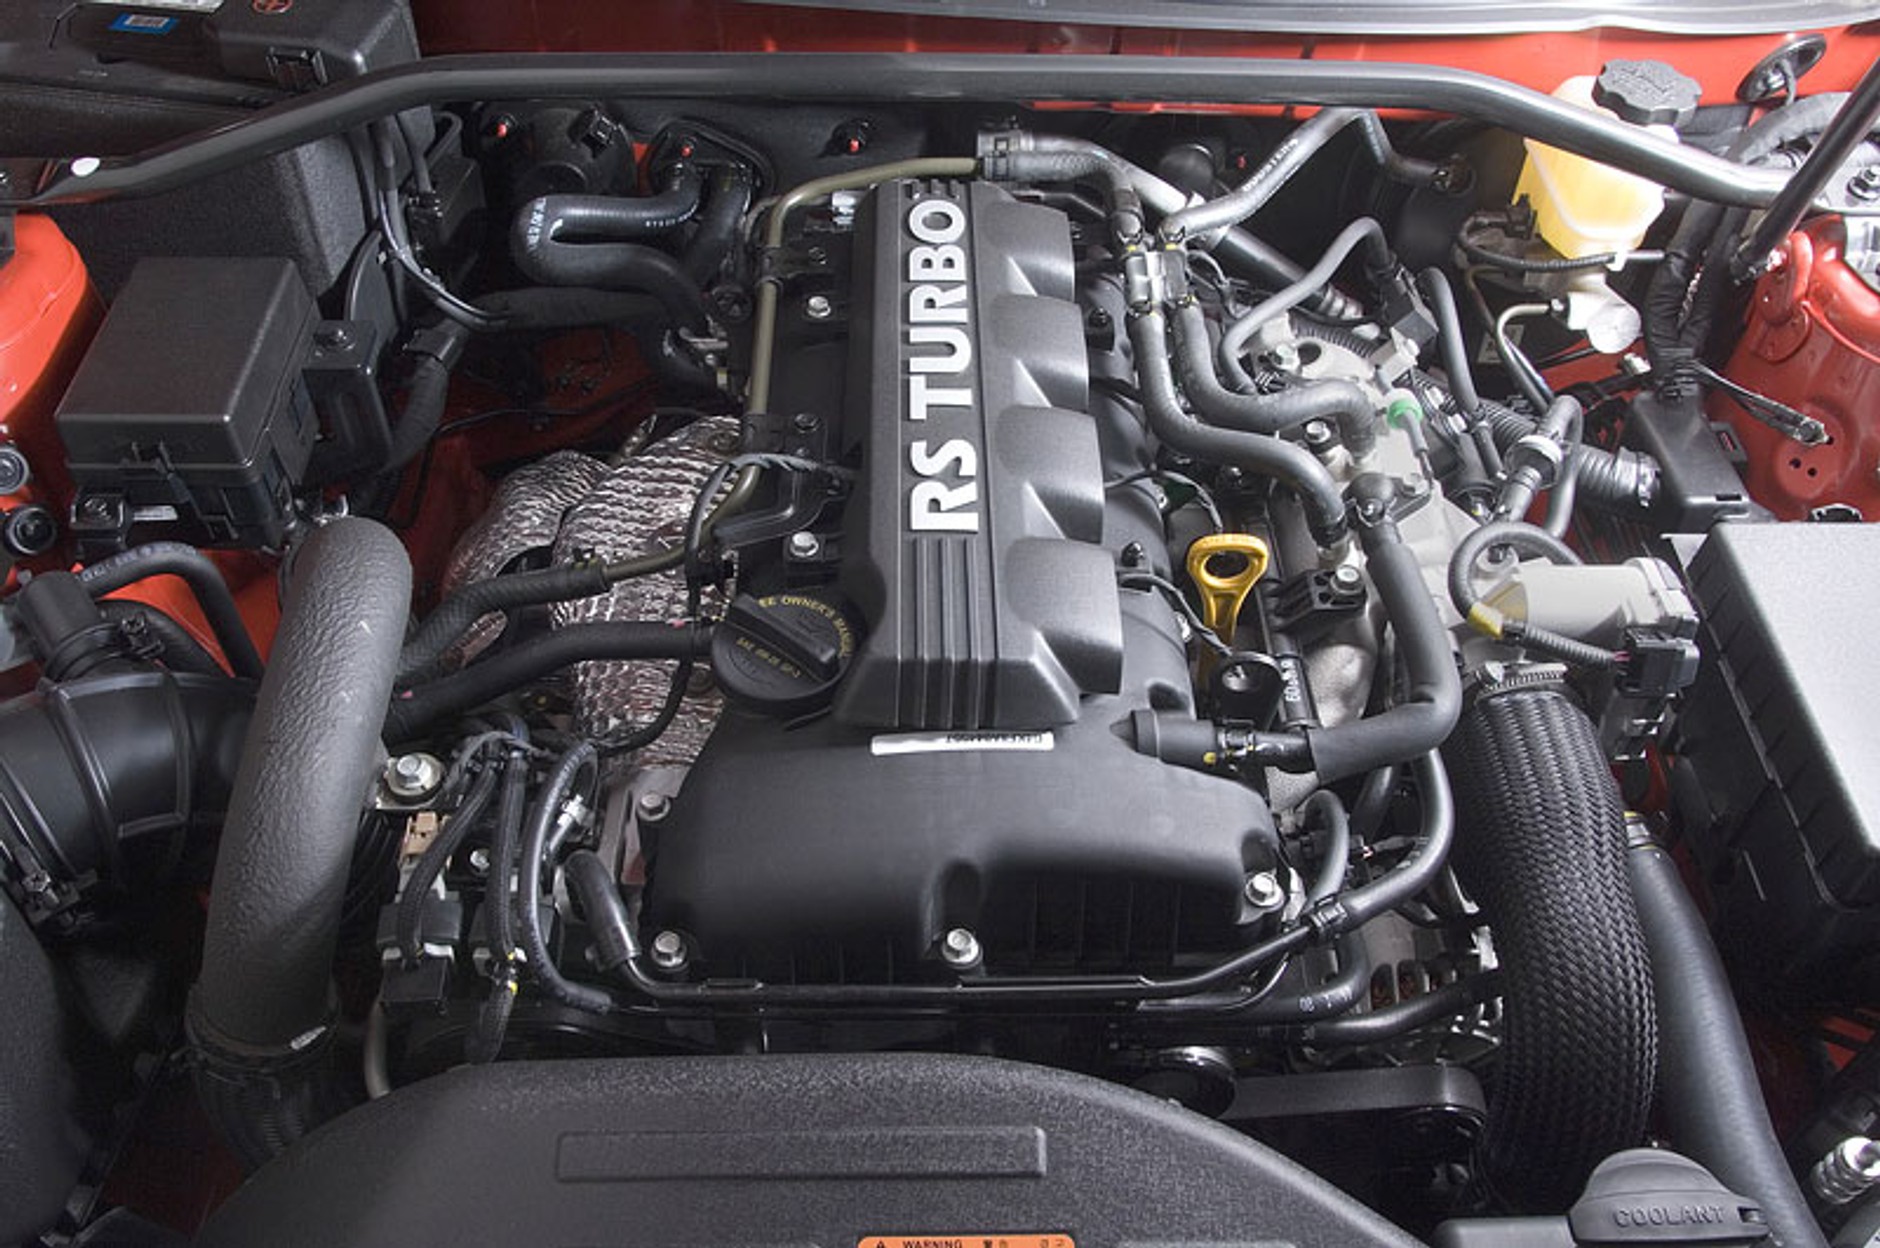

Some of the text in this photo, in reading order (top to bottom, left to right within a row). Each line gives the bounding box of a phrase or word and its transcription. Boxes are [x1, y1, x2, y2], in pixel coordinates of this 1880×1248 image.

[908, 198, 979, 532] RS TURBO
[1612, 1205, 1723, 1228] COOLANT
[902, 1239, 963, 1248] WARNING
